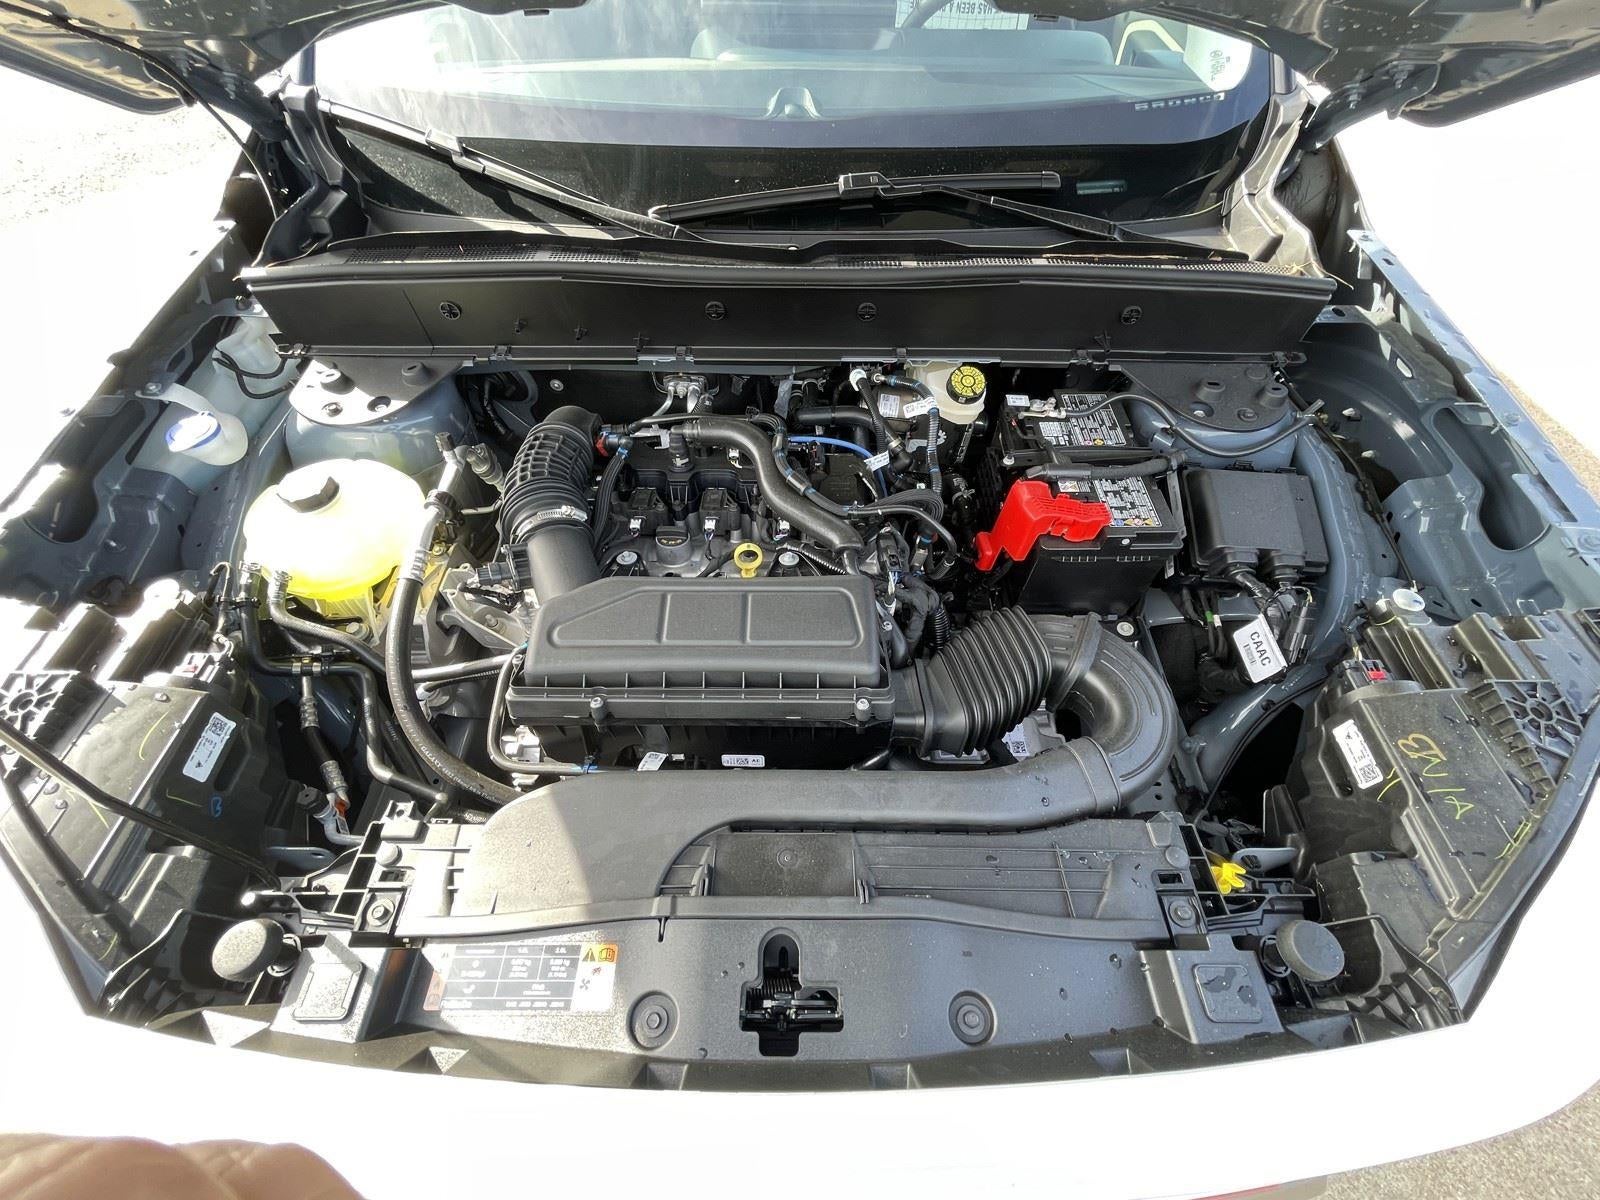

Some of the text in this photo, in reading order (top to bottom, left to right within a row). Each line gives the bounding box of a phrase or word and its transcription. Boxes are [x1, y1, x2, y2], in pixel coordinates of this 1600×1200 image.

[956, 3, 976, 14] BEEN
[977, 3, 993, 15] HAS
[1250, 631, 1271, 667] CAAC
